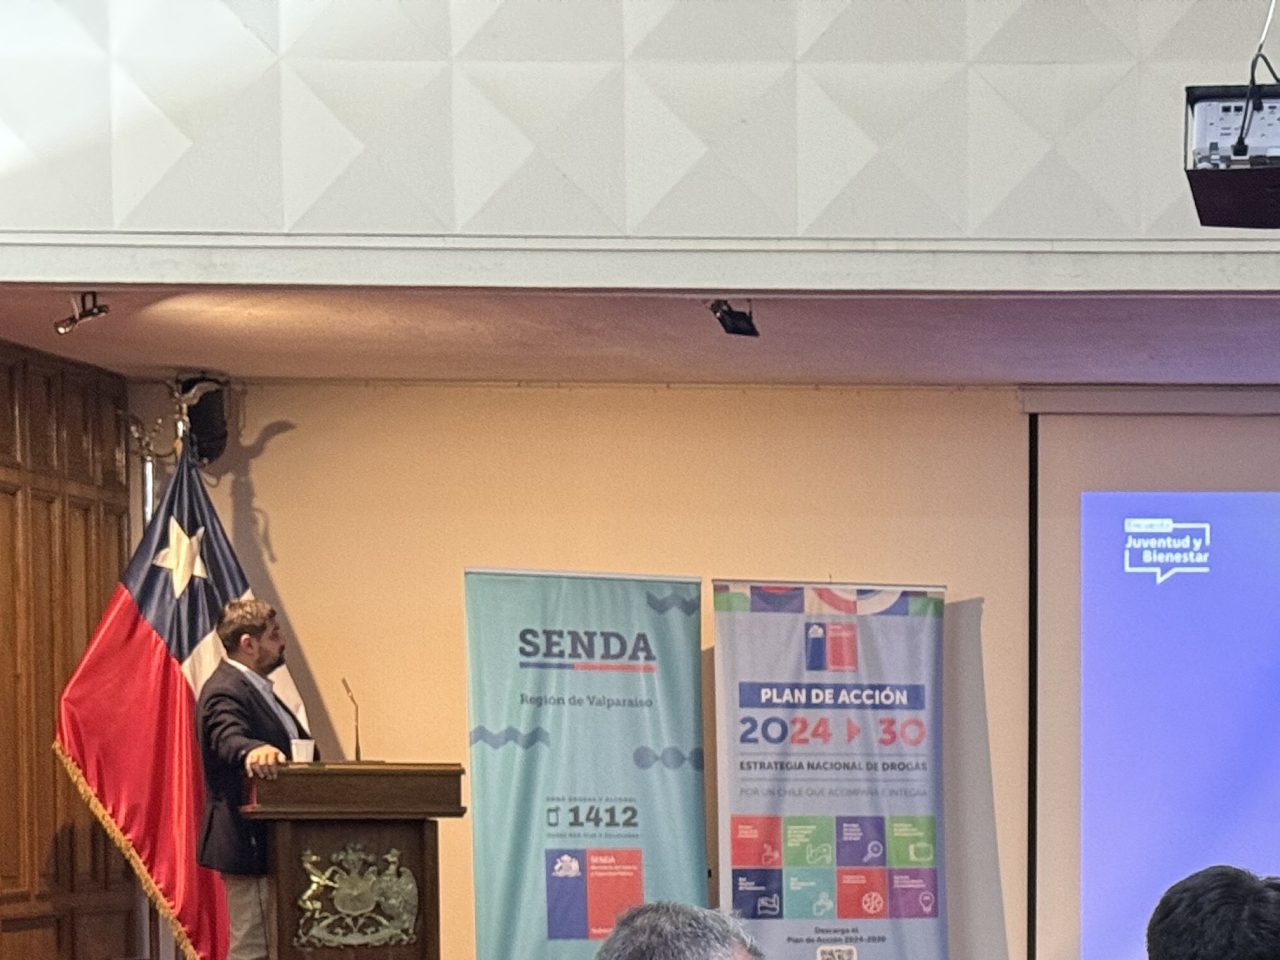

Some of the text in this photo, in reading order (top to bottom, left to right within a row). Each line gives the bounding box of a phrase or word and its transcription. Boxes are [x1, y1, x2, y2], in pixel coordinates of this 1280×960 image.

[1126, 535, 1202, 552] Juventud y
[1142, 549, 1209, 563] Bienestar
[518, 628, 656, 662] SENDA
[520, 693, 566, 708] Región
[569, 694, 584, 707] de
[760, 686, 909, 705] PLAN DE ACCIÓN
[739, 716, 927, 746] 2024 30
[739, 761, 928, 772] ESTRATEGIA NACIONAL DE DROGAS
[568, 805, 639, 828] 1412
